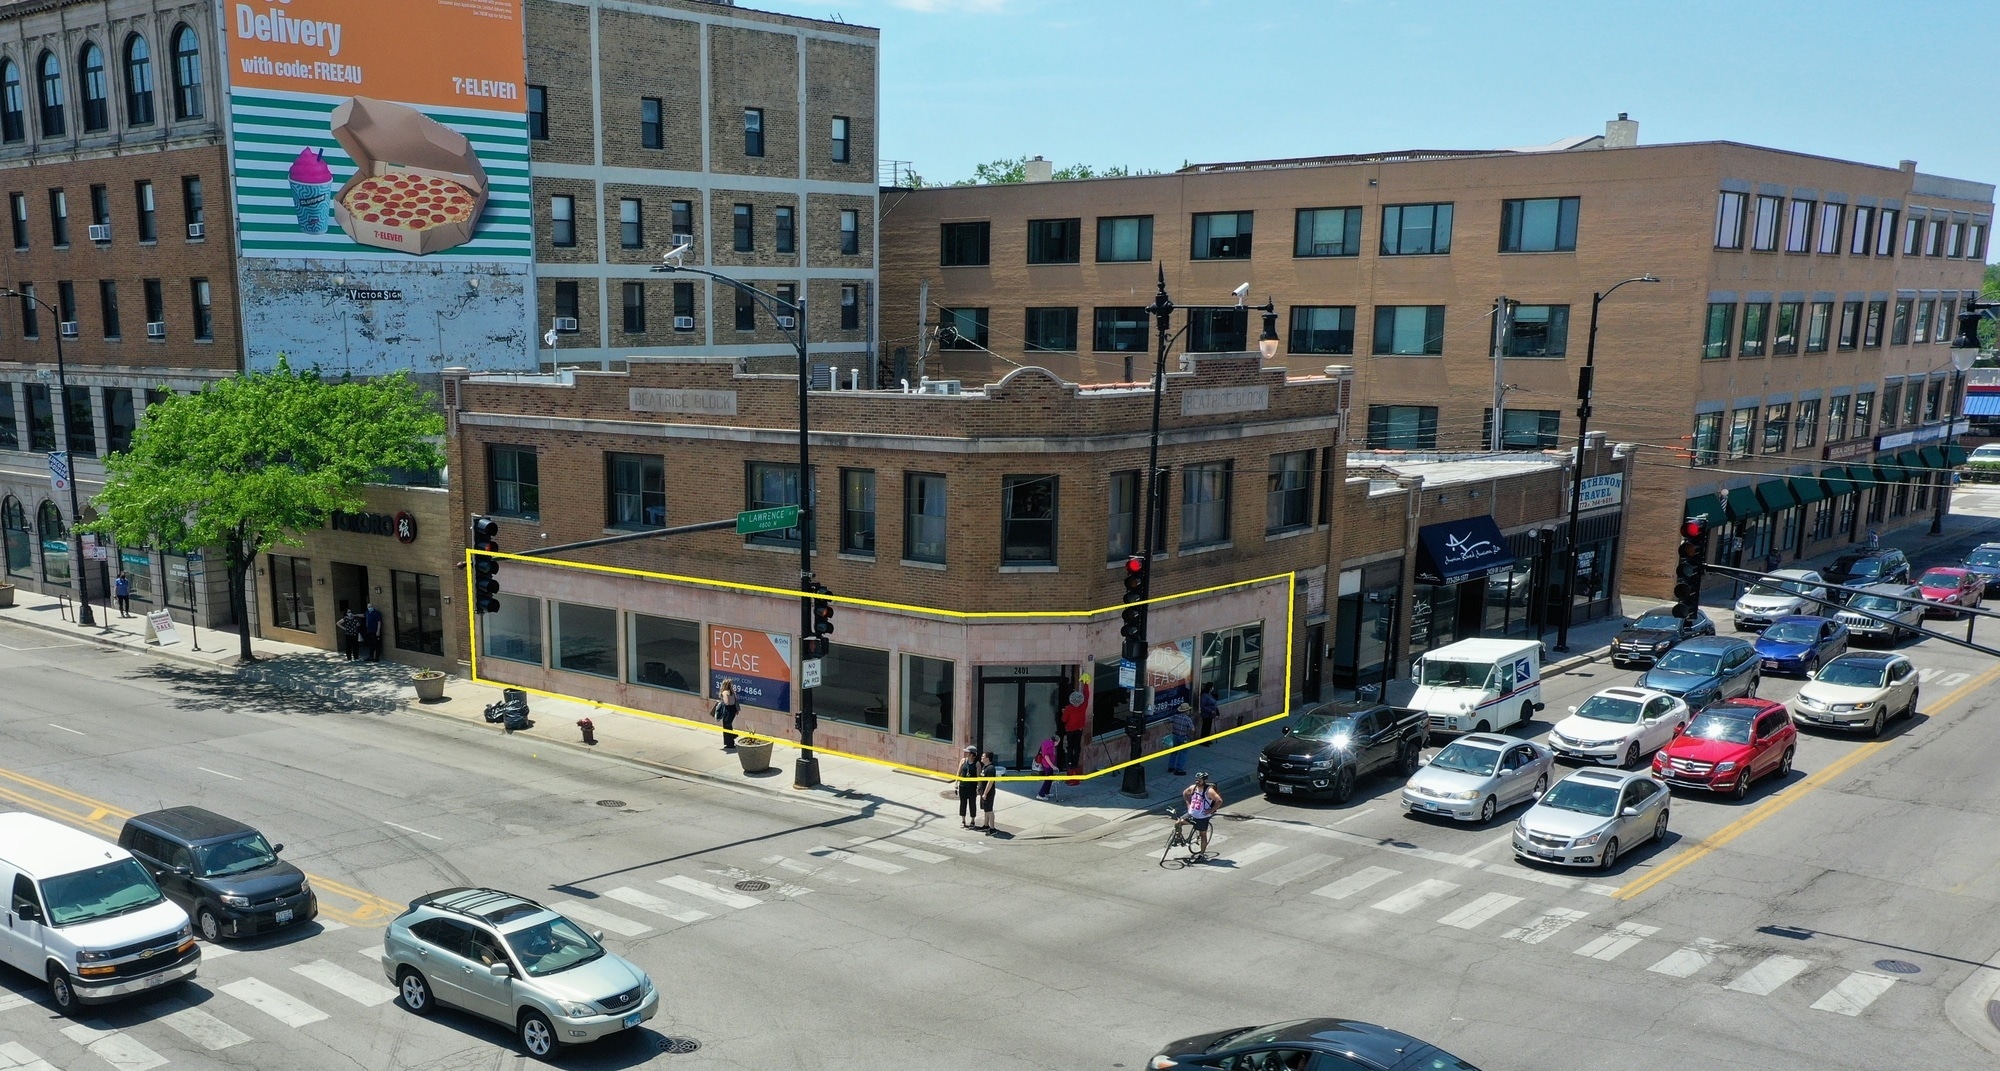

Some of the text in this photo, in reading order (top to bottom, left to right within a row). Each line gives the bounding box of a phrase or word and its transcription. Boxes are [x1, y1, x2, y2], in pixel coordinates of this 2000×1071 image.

[236, 3, 341, 57] Delivery
[241, 56, 362, 85] with code: FREE4U
[634, 392, 731, 409] BEATRICE BLOCK
[1186, 391, 1264, 411] BEATRICE BLOCK
[1569, 476, 1621, 497] PRTHENON
[1579, 488, 1611, 501] TRAVEL
[749, 510, 784, 523] LAWRENCE
[714, 630, 743, 651] FOR
[714, 649, 760, 673] LEASE
[1014, 667, 1029, 675] 2401
[715, 681, 762, 696] 3189-4864
